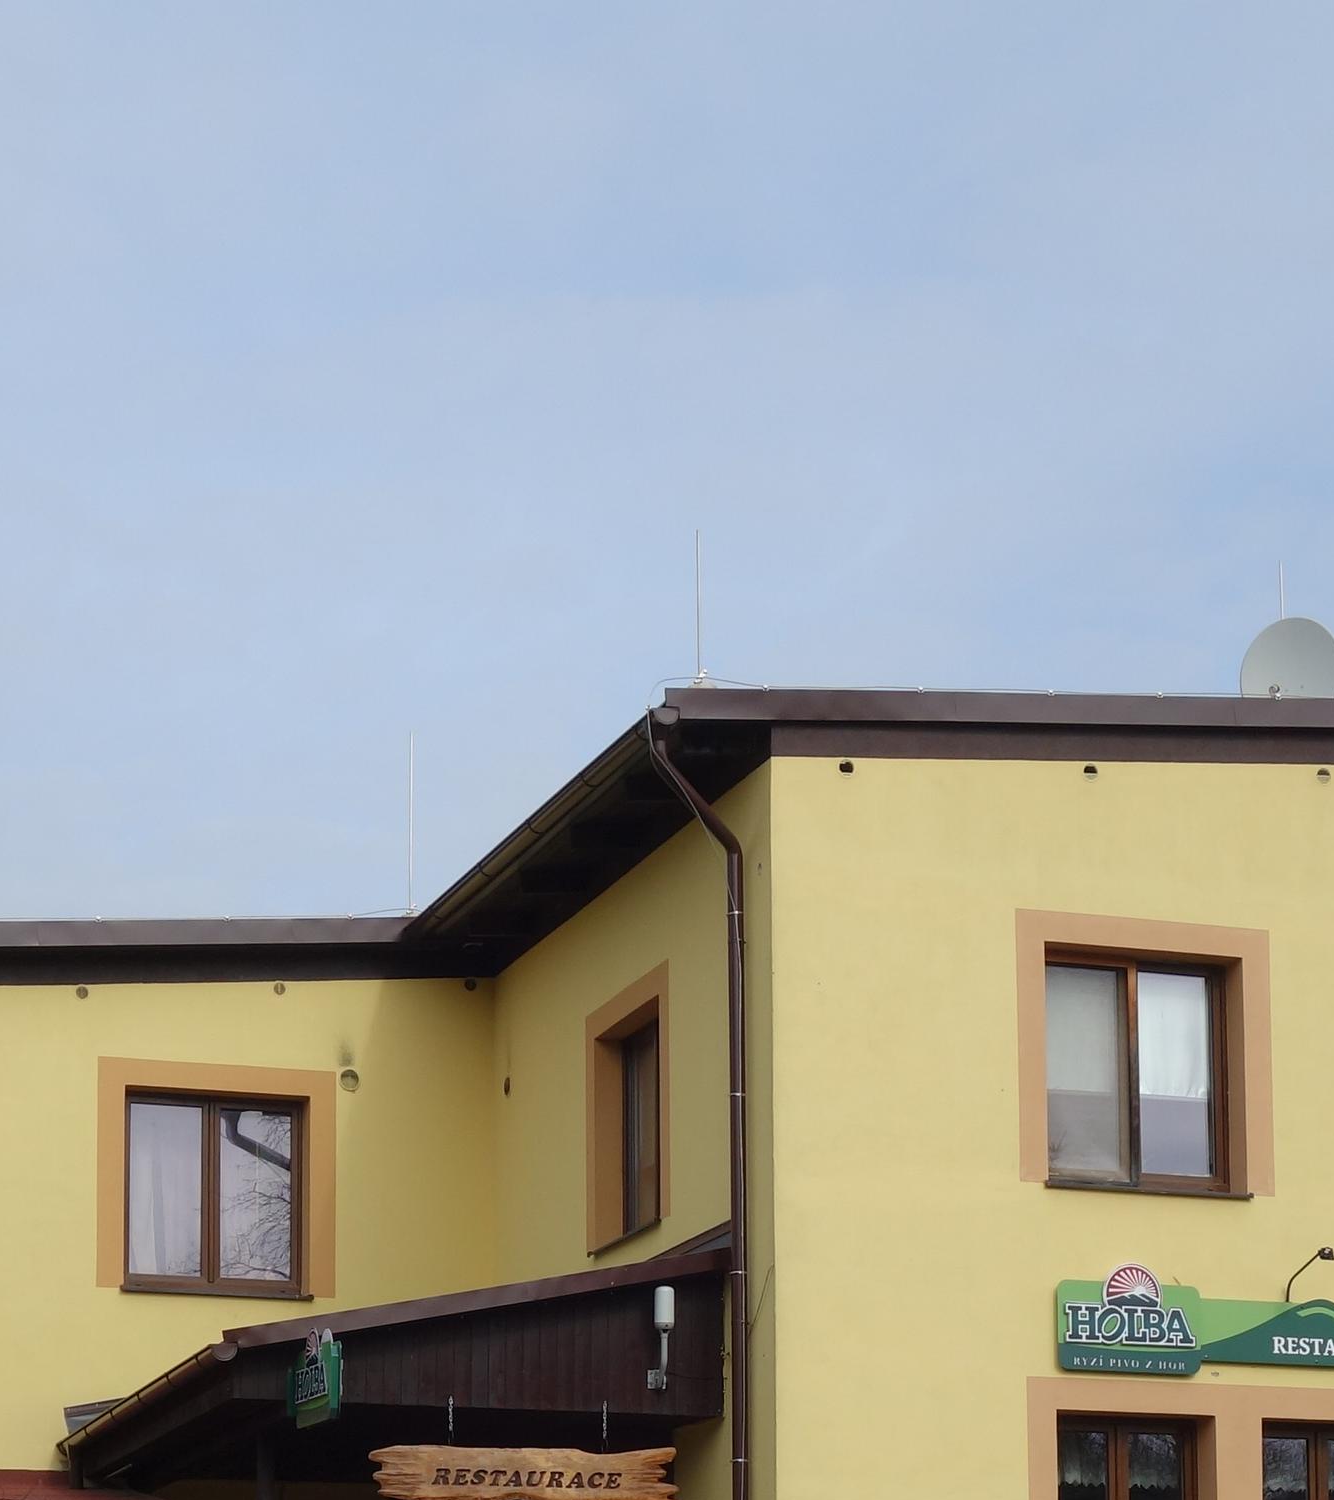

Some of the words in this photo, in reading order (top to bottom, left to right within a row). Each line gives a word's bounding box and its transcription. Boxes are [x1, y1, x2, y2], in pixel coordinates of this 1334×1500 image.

[1065, 1303, 1196, 1347] HOLBA
[1073, 1355, 1104, 1366] RYZÍ
[1109, 1358, 1140, 1369] PIVO
[1145, 1361, 1154, 1369] Z
[1159, 1362, 1186, 1371] HOR
[294, 1363, 328, 1404] HOLBA
[431, 1468, 623, 1489] RESTAURACE
